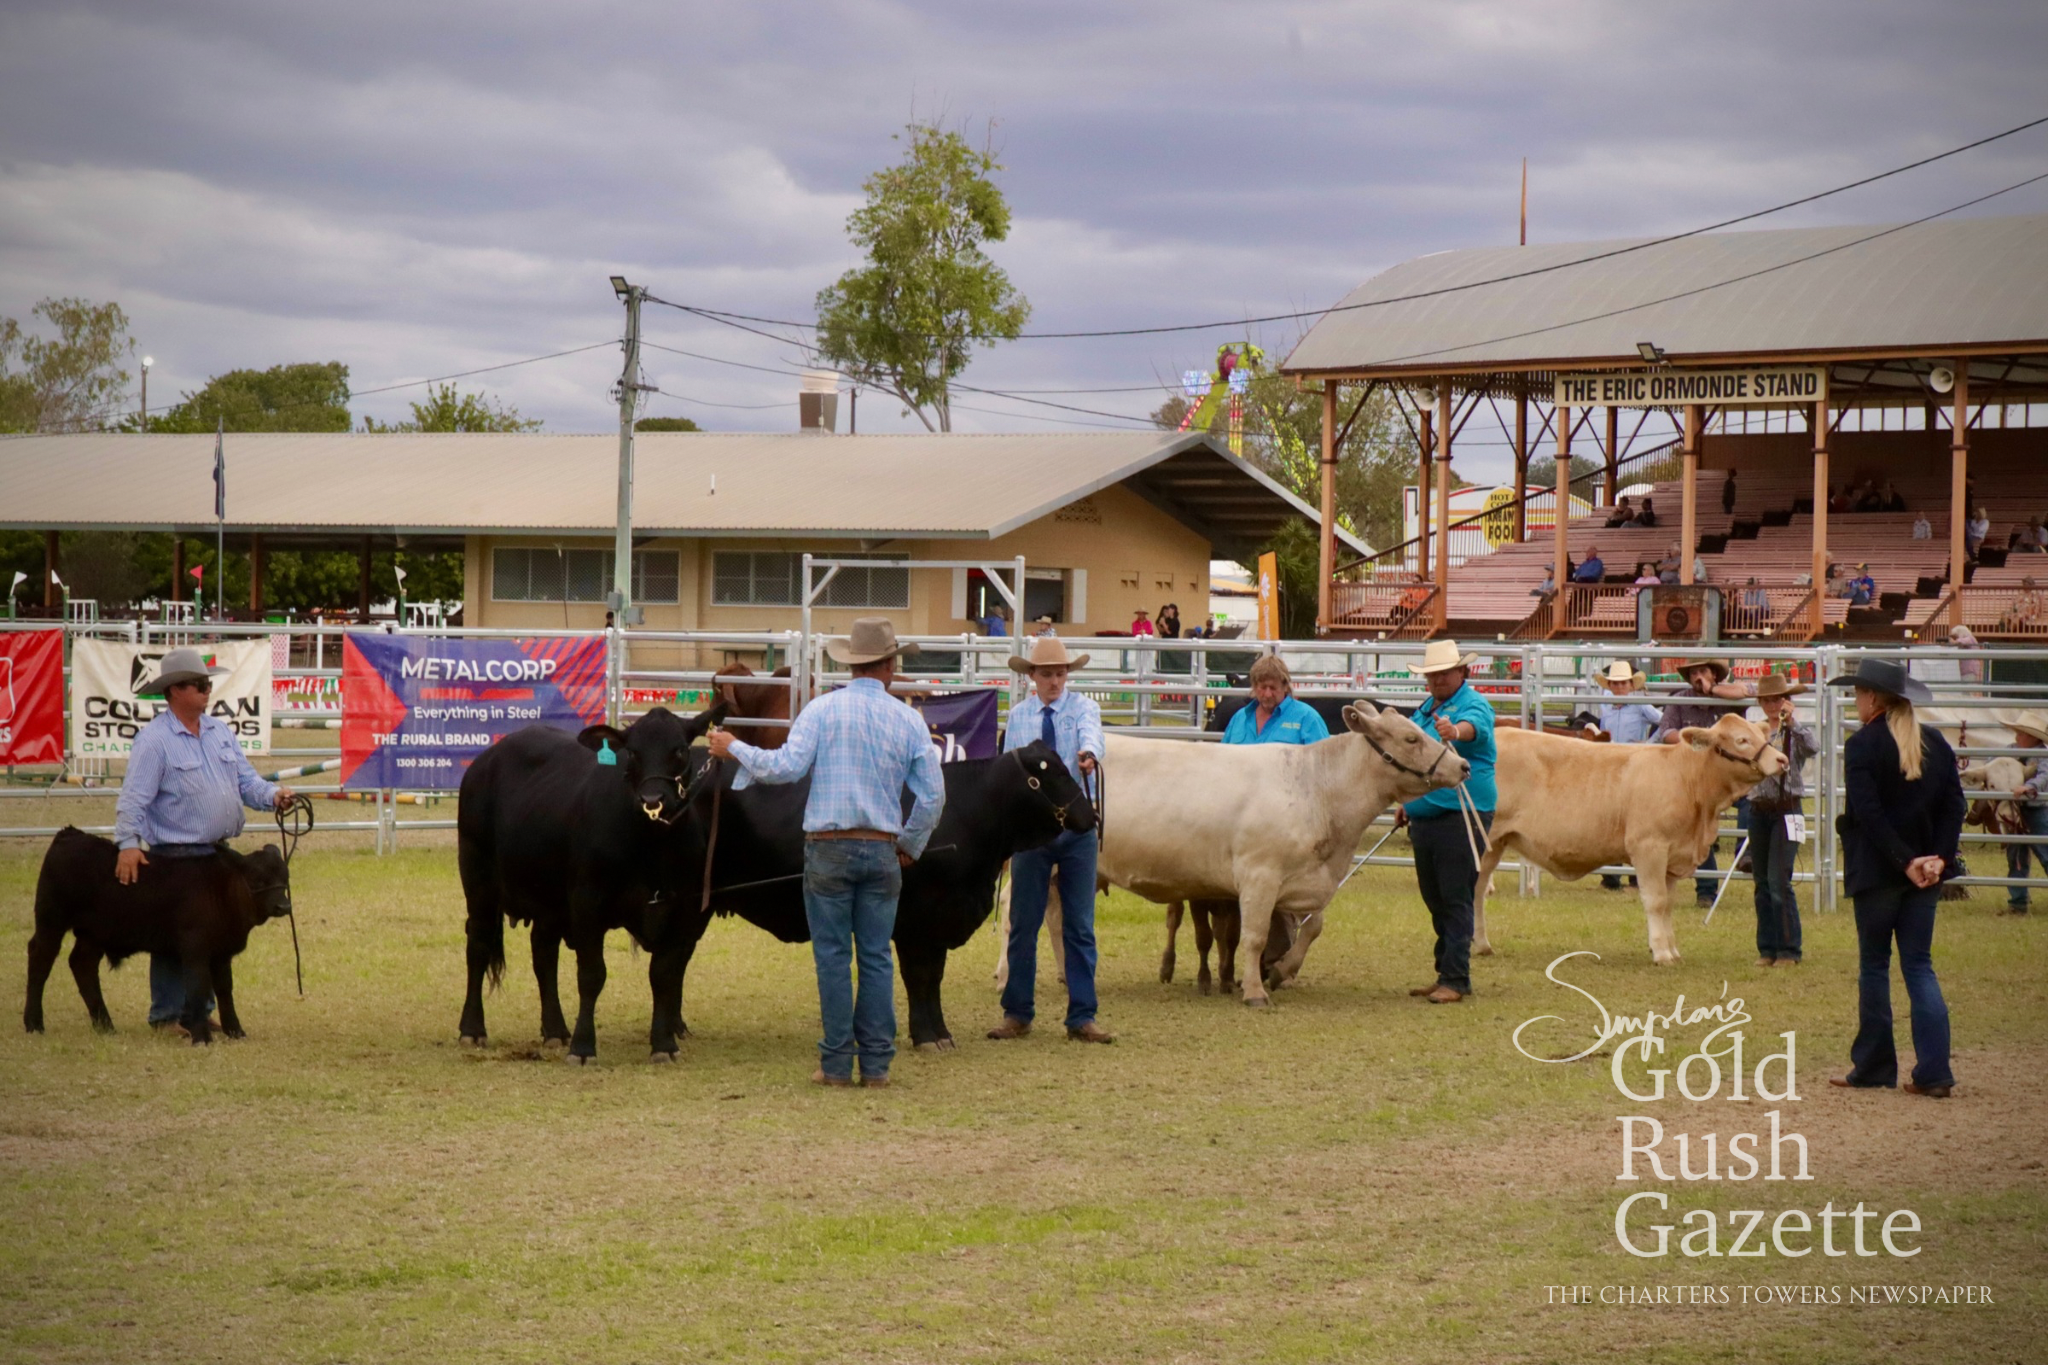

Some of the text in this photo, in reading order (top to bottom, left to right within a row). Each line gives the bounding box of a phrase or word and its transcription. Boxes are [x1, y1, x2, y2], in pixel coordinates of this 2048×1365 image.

[1562, 372, 1818, 401] THE ERIC ORMONDE STAND
[1488, 525, 1514, 540] FOO
[401, 656, 557, 682] METALCORP
[414, 705, 541, 722] Everything in Steel
[372, 733, 398, 745] THE
[401, 733, 443, 745] RURAL
[445, 733, 490, 746] BRAND
[396, 758, 416, 767] 1300
[418, 758, 435, 767] 306
[436, 758, 452, 768] 204
